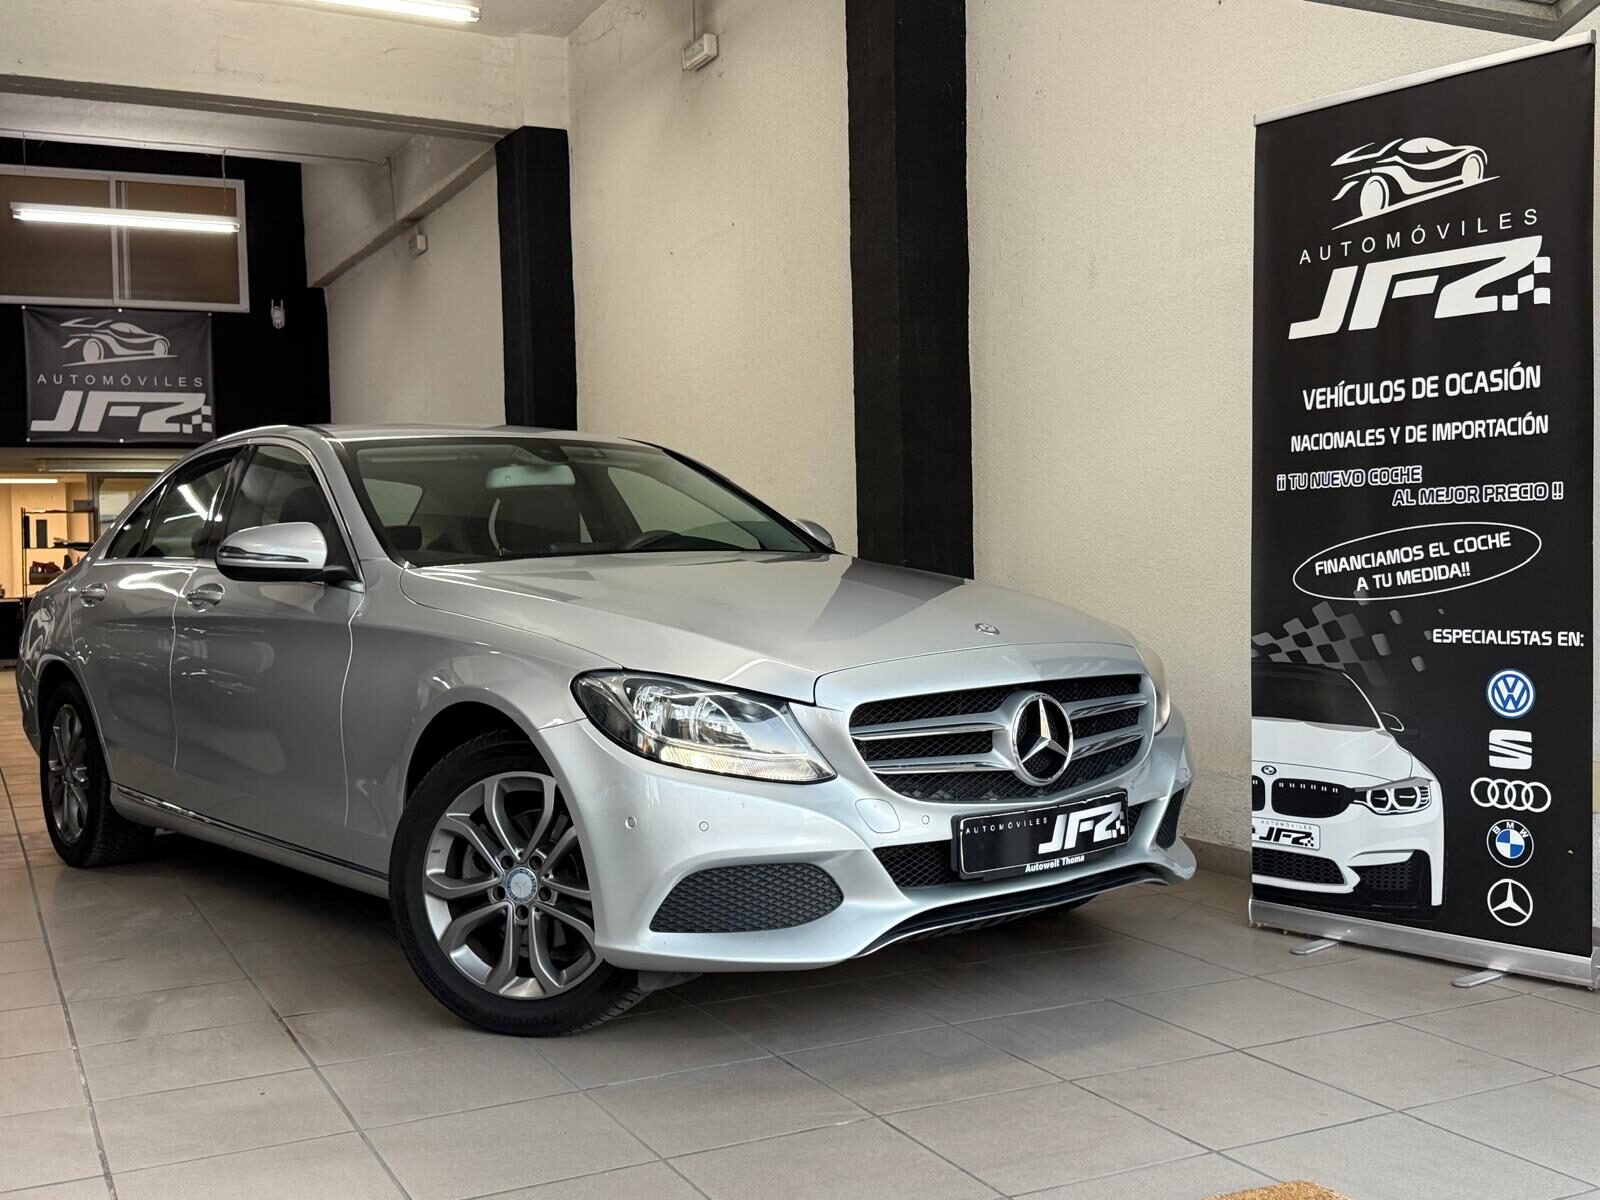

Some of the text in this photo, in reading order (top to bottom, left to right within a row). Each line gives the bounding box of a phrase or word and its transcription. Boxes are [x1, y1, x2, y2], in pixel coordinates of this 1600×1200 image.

[1299, 208, 1538, 265] AUTOMÓVILES
[1288, 235, 1550, 340] JFZ
[36, 373, 204, 388] AUTOMÓVILES
[1302, 361, 1541, 411] VEHÍCULOS DE OCASIÓN
[30, 390, 212, 434] JFZ
[1290, 411, 1549, 453] NACIONALES Y DE IMPORTACIÓN
[1288, 472, 1308, 491] TU
[1310, 468, 1366, 490] NUEVO
[1368, 465, 1423, 486] COCHE
[1392, 481, 1564, 507] AL MEJOR PRECIO !!
[1314, 531, 1512, 576] FINANCIAMOS EL COCHE
[1356, 561, 1471, 592] A TU MEDIDA!!
[1432, 628, 1585, 647] ESPECIALISTAS EN:
[965, 816, 1048, 835] AUTOMÓVILES
[1492, 821, 1529, 839] BMW
[1062, 855, 1085, 866] Thoma
